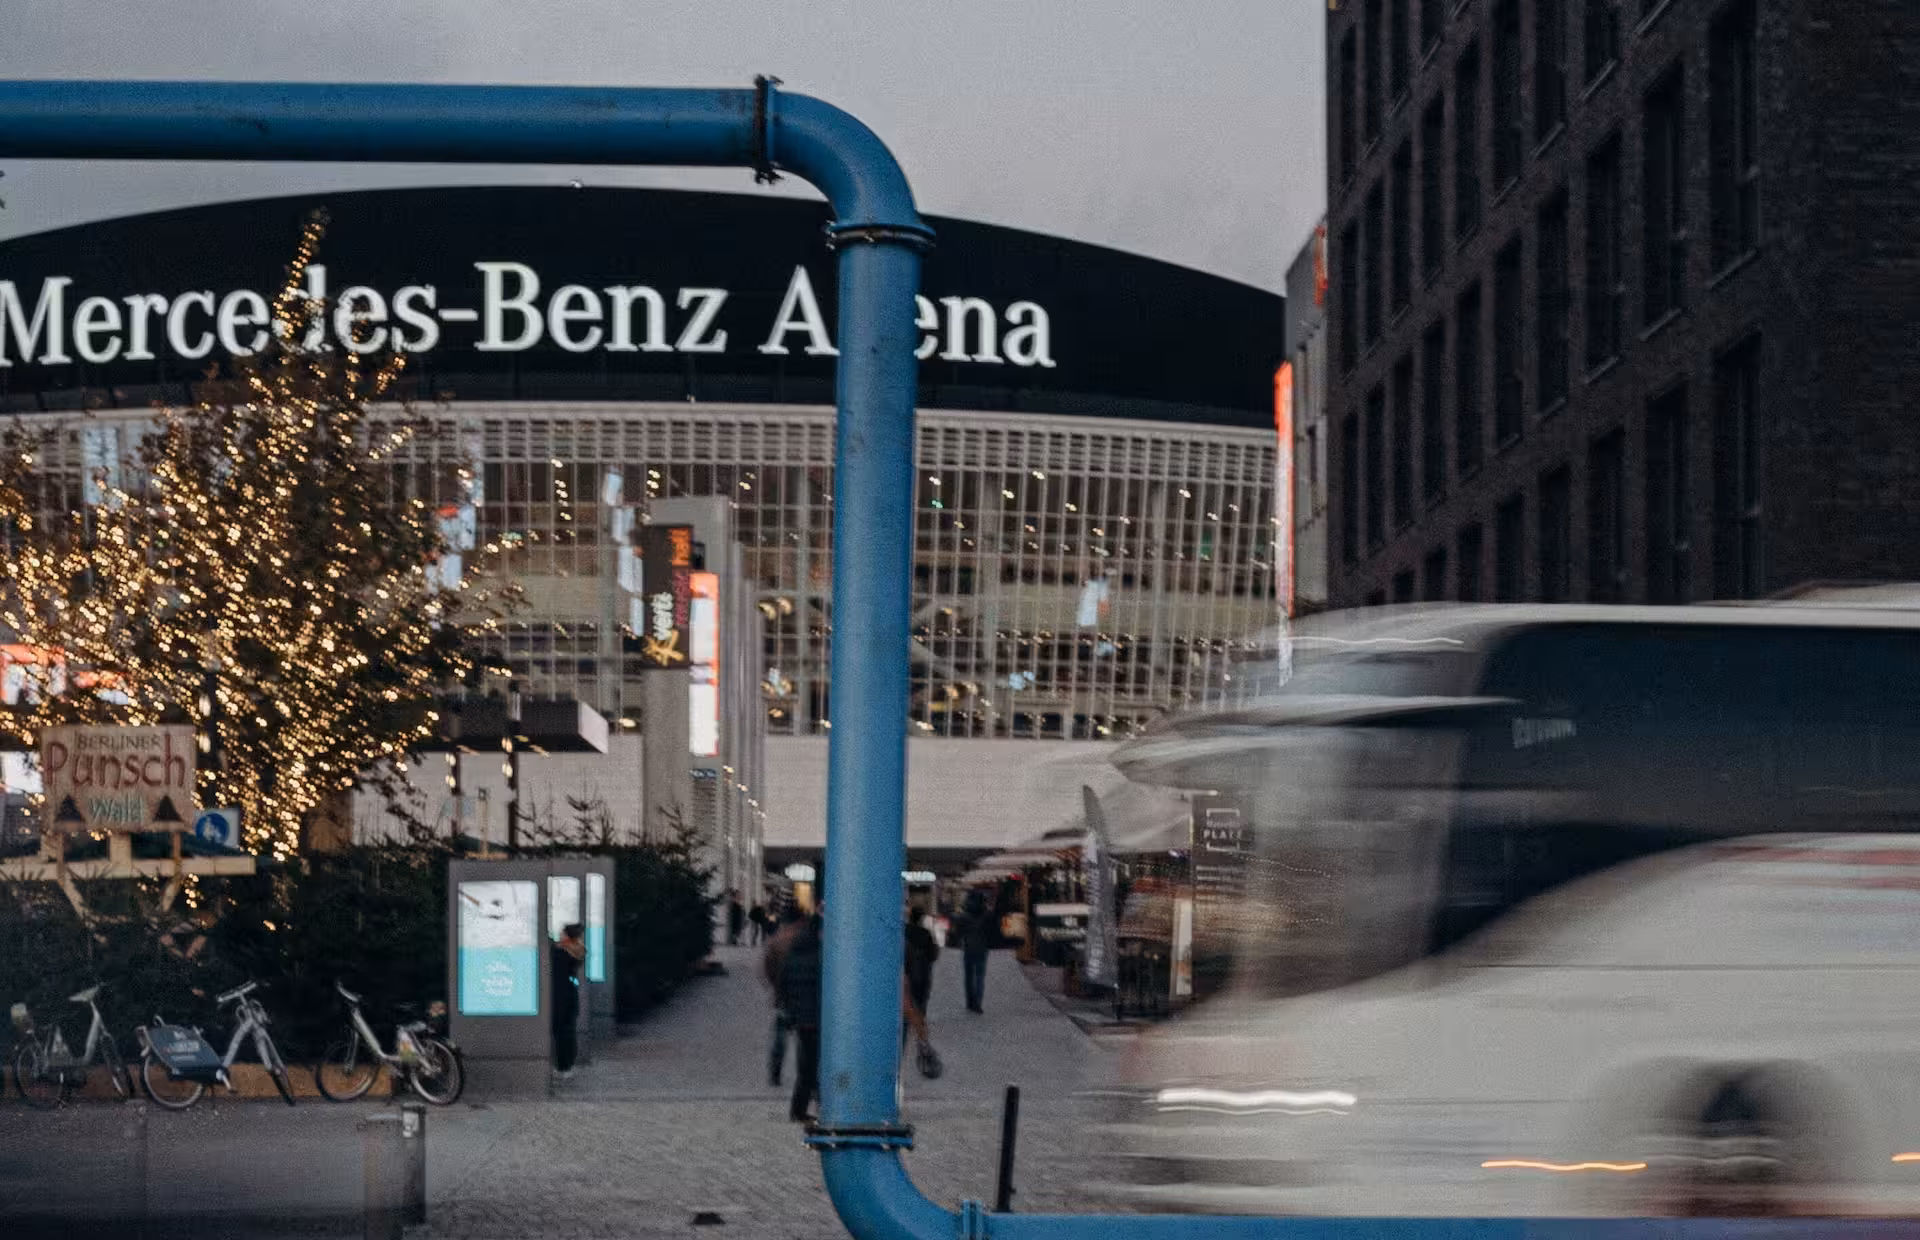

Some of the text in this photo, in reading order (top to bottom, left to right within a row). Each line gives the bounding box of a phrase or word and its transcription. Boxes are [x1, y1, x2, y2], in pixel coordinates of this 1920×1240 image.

[0, 261, 1057, 368] Mercedes-Benz Ana
[44, 732, 187, 789] Punsch
[76, 733, 161, 750] BERLINER
[90, 794, 144, 824] Wald
